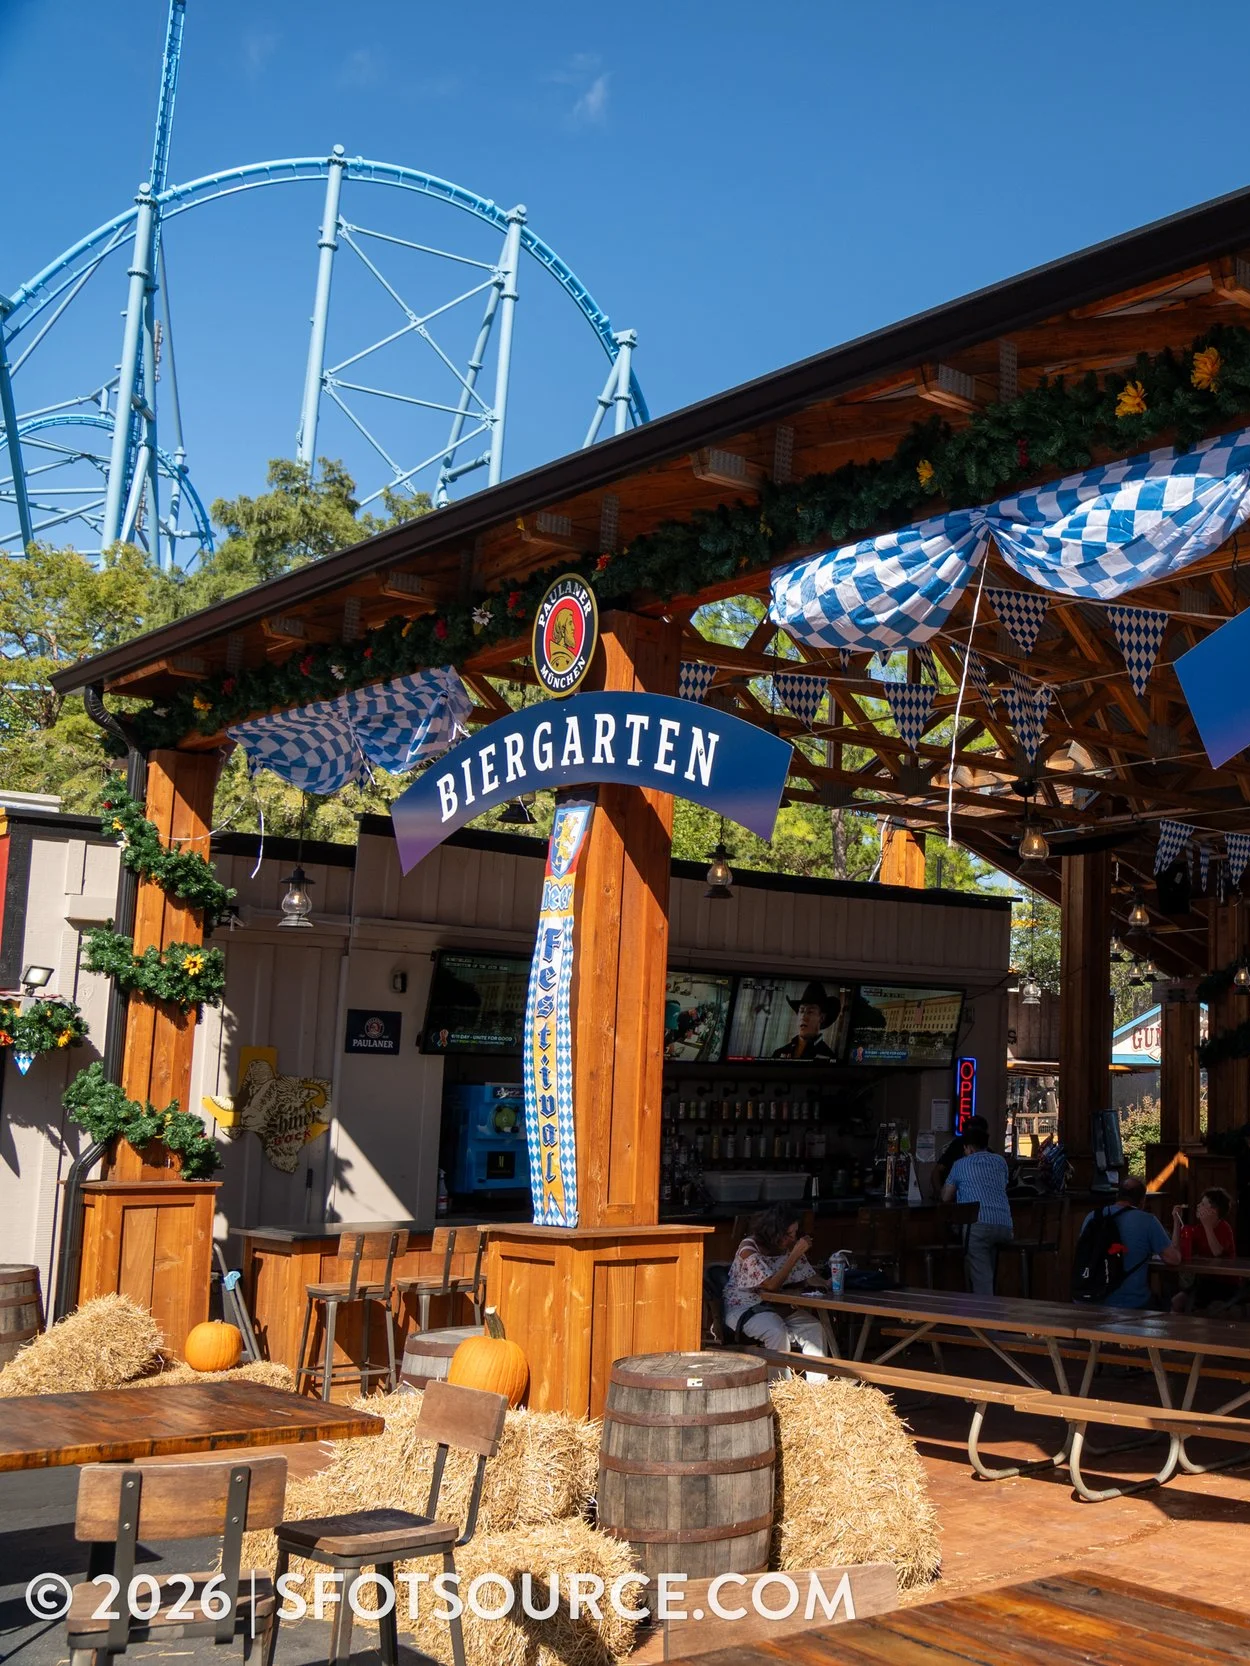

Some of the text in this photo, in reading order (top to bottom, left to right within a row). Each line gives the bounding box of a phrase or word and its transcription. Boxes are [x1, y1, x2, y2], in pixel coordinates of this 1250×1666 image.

[538, 580, 592, 628] PAULANER
[540, 656, 586, 689] MÜNCHEN
[436, 713, 720, 824] BIERGARTEN
[352, 1038, 394, 1048] PAULANER
[536, 927, 564, 1184] Festival
